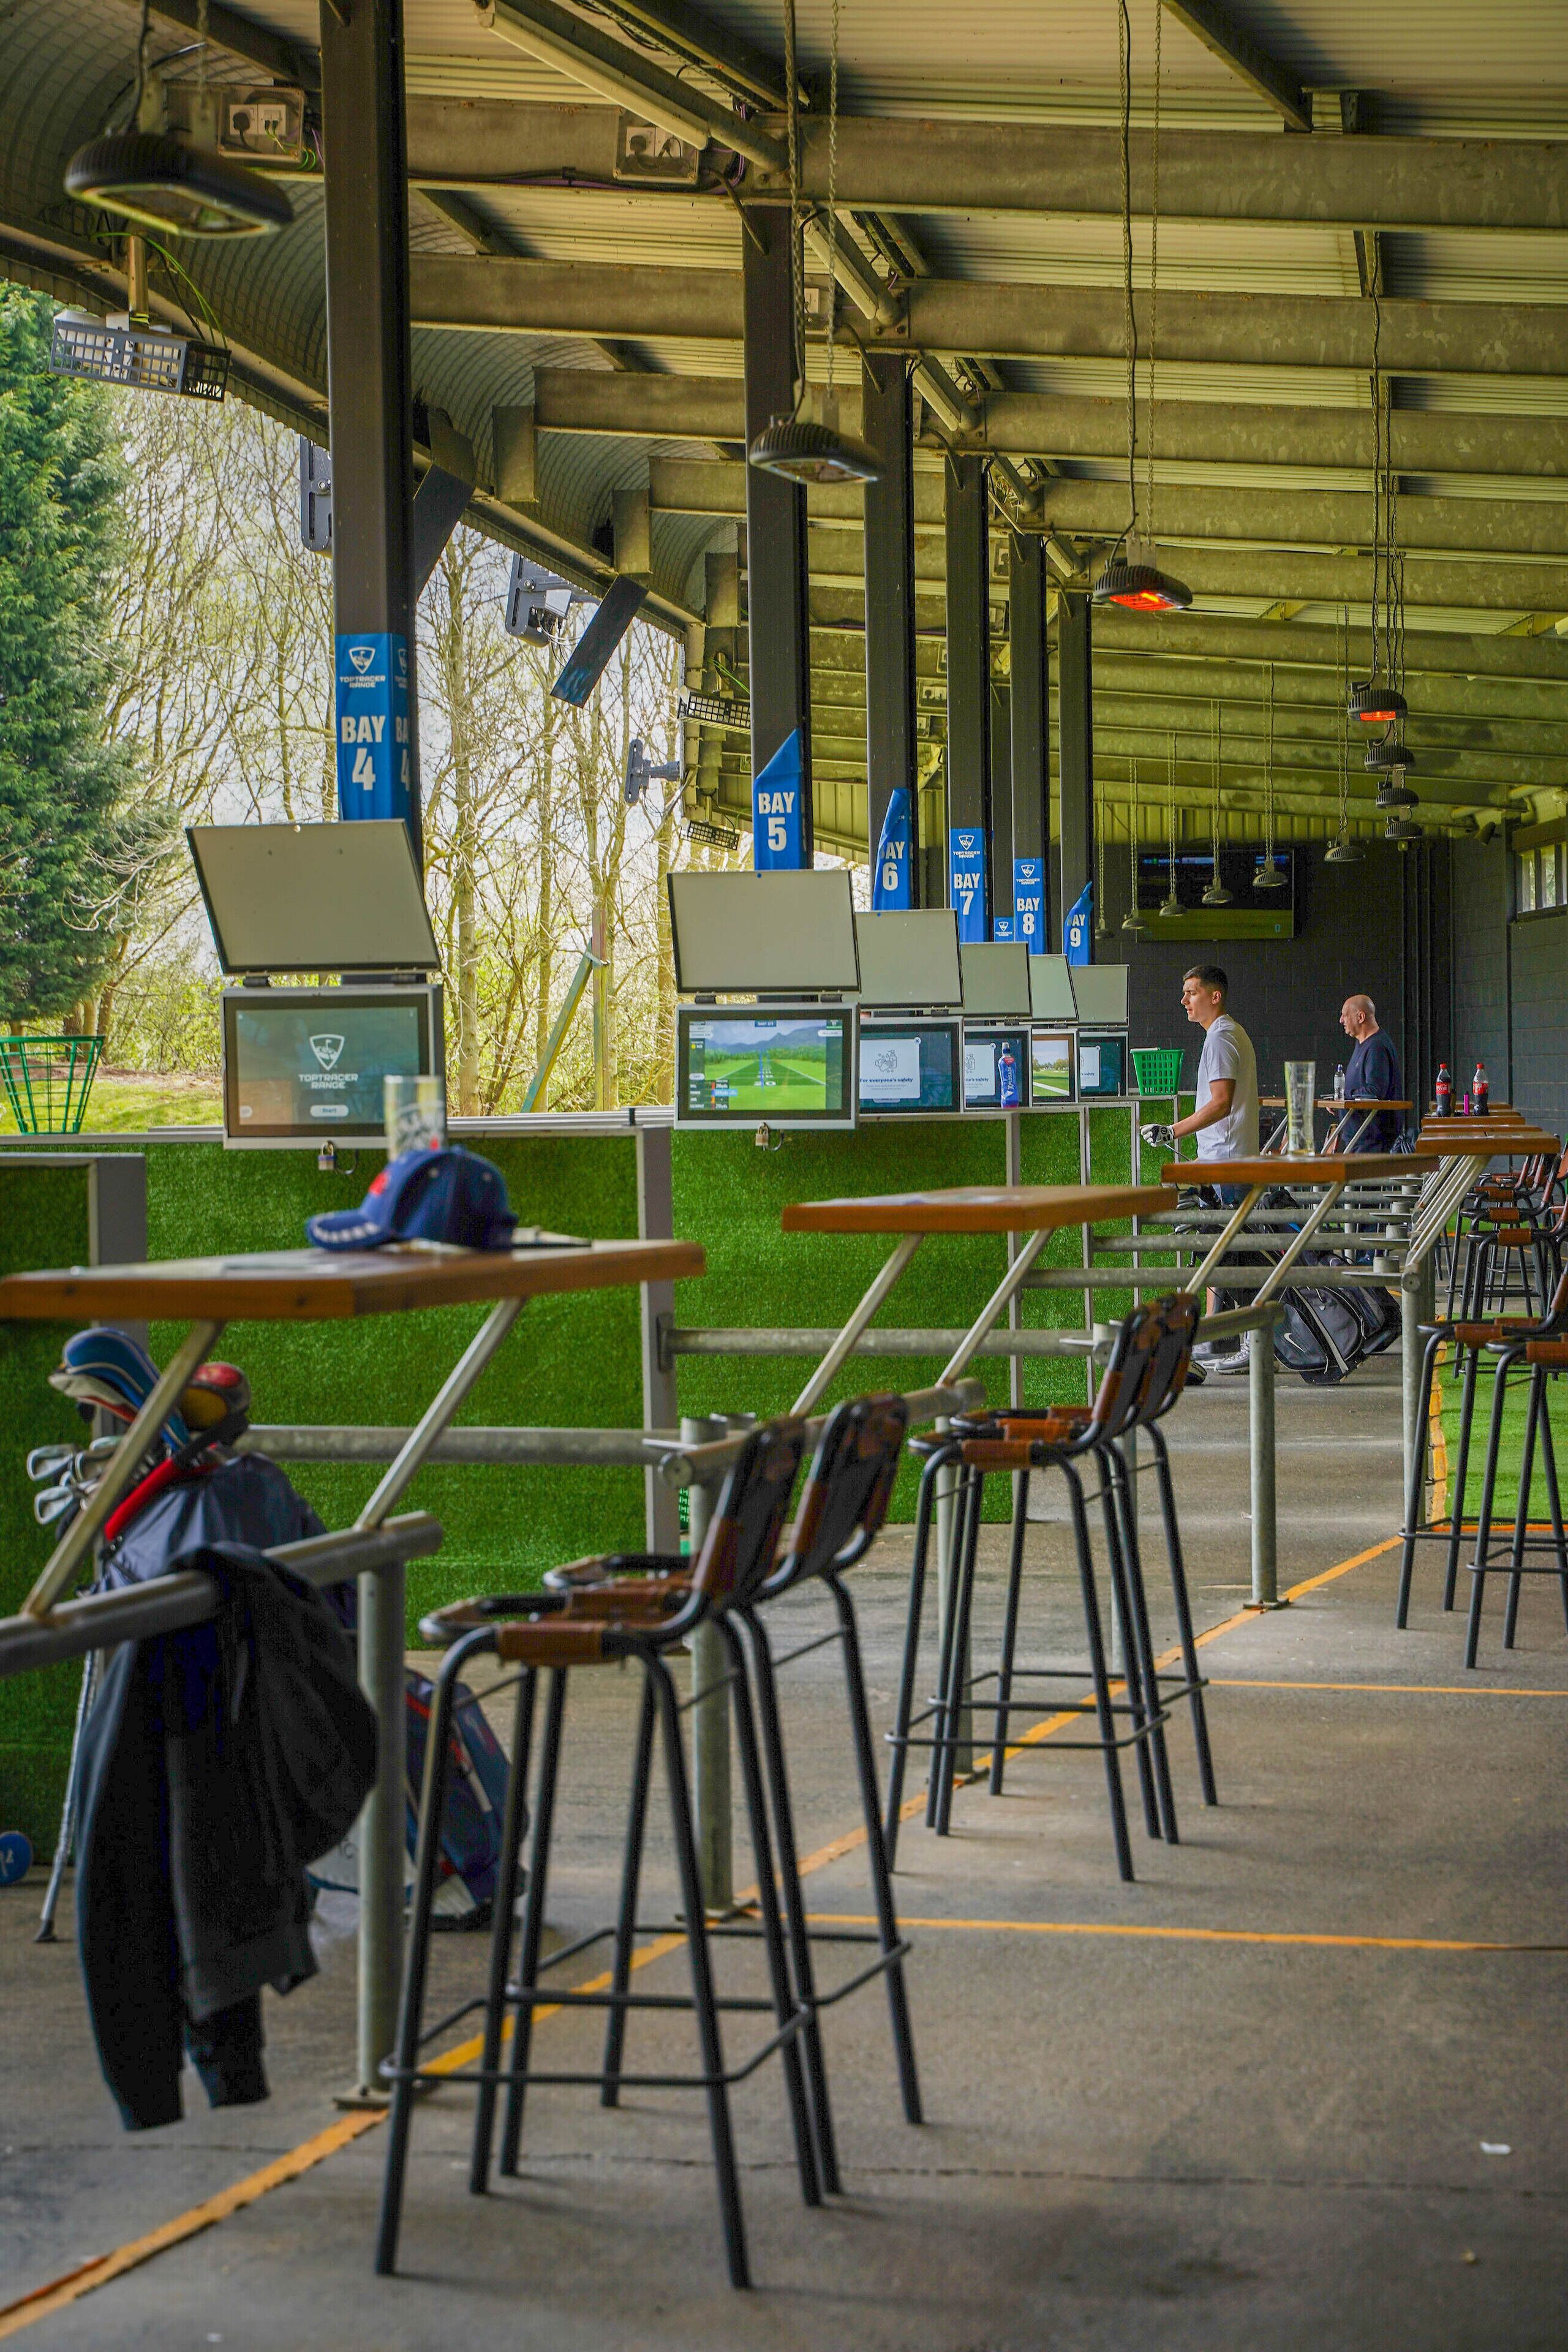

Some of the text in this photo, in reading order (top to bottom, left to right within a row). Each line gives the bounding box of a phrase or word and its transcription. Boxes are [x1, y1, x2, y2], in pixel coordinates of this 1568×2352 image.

[341, 715, 386, 744] BAY
[352, 748, 376, 791] 4
[758, 792, 795, 814] BAY
[767, 817, 787, 851] 5
[882, 862, 898, 891] 6
[954, 873, 981, 889] BAY
[960, 891, 974, 915] 7
[1017, 898, 1040, 911] BAY
[1023, 913, 1035, 935] 8
[1070, 928, 1081, 948] 9
